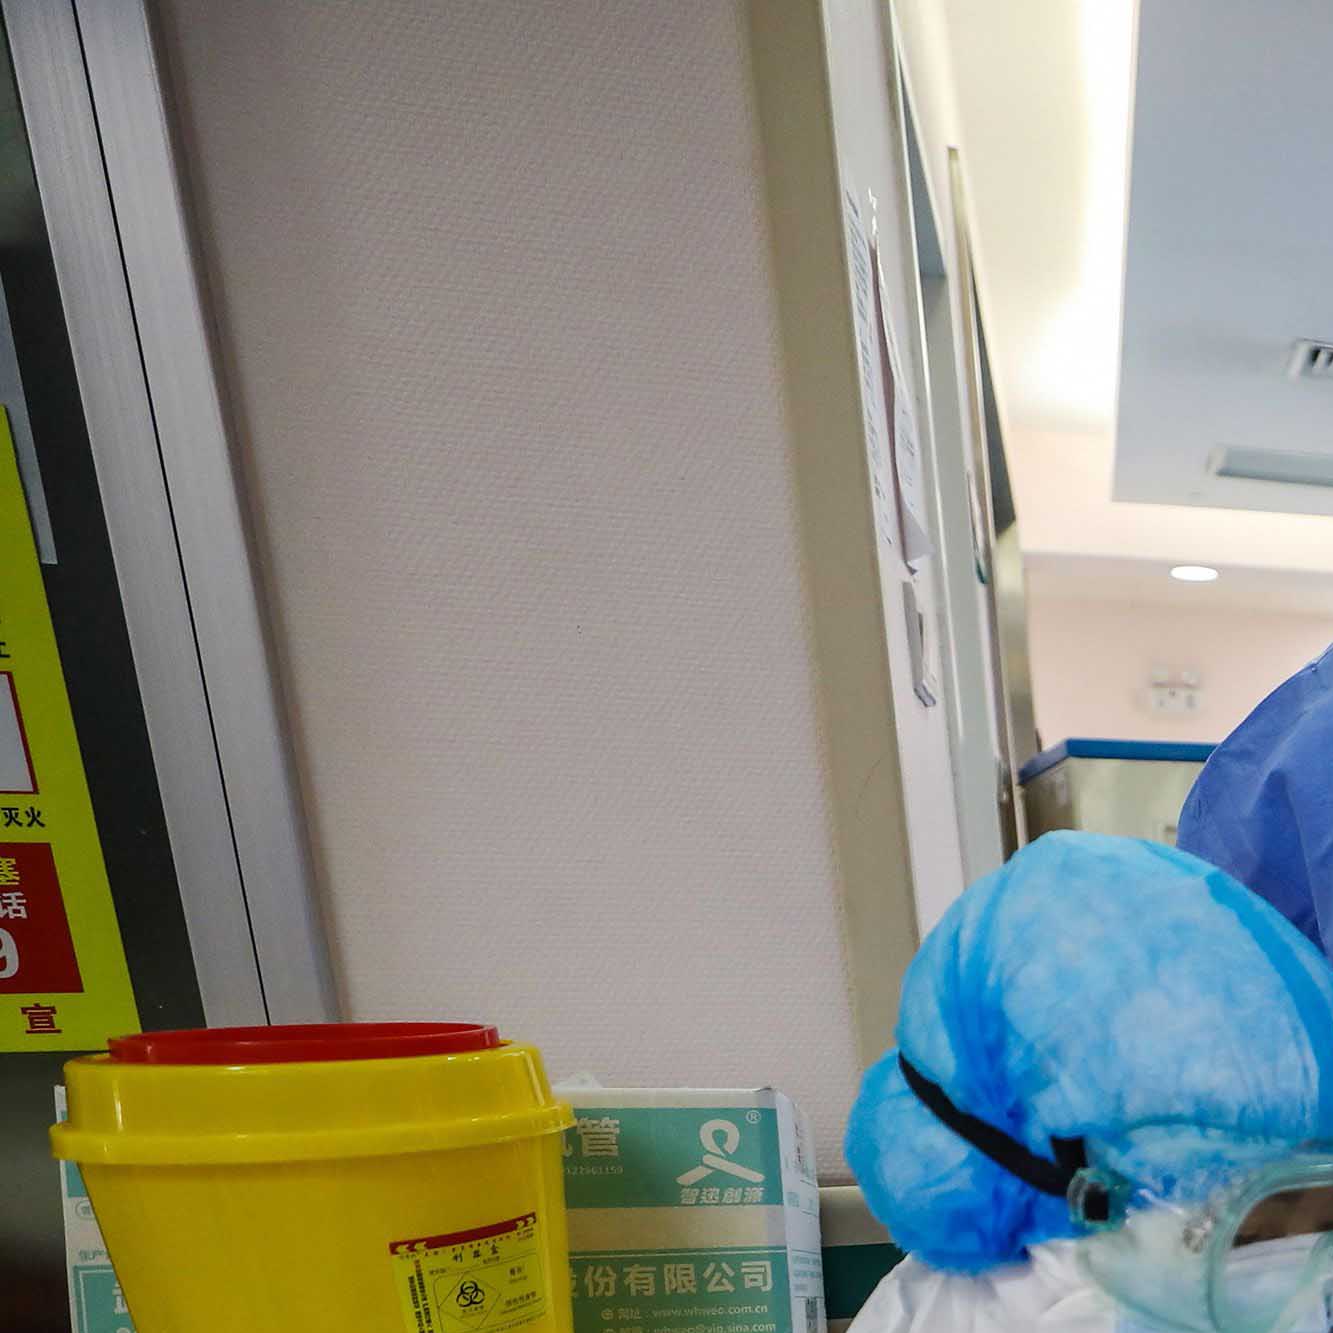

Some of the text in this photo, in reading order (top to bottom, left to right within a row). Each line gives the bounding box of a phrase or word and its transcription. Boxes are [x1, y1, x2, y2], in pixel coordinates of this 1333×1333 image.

[20, 1003, 63, 1034] 宣
[568, 1260, 775, 1298] 份有限公司
